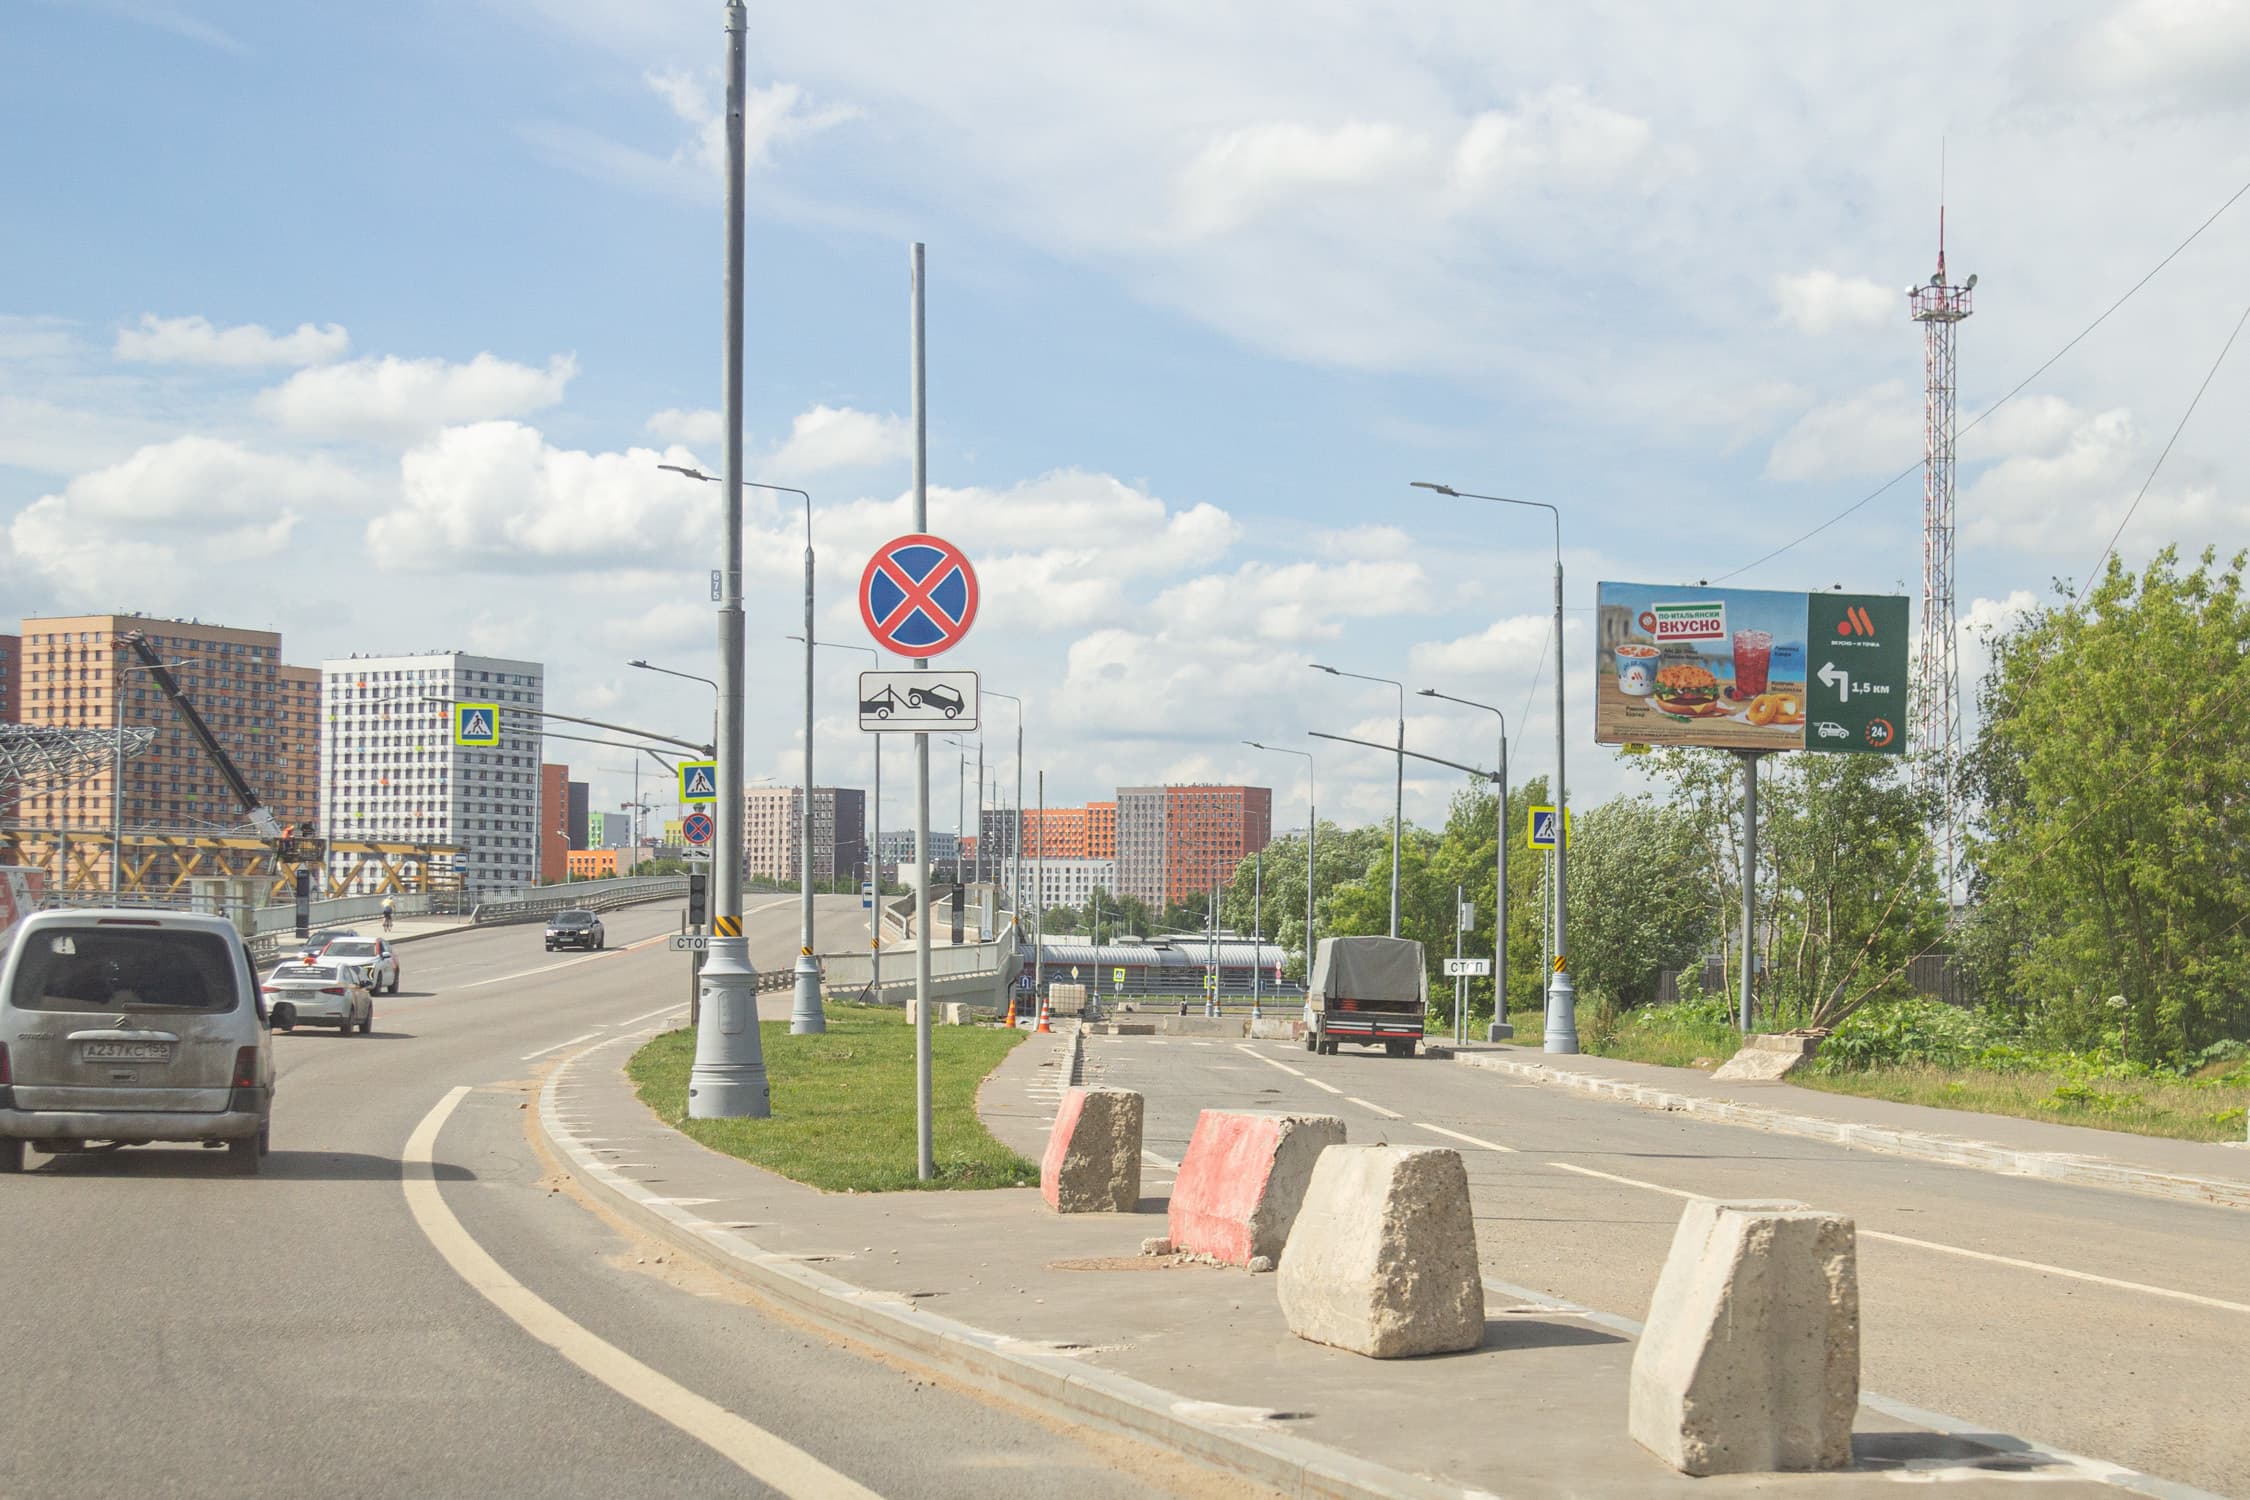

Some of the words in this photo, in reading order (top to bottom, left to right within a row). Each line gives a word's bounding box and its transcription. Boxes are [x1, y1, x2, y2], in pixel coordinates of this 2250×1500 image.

[1659, 611, 1720, 620] ПО-ИТАЛЬЯНСКИ
[1660, 619, 1721, 633] ВКУСНО
[1852, 682, 1871, 694] 1,5
[1450, 962, 1483, 973] СТП
